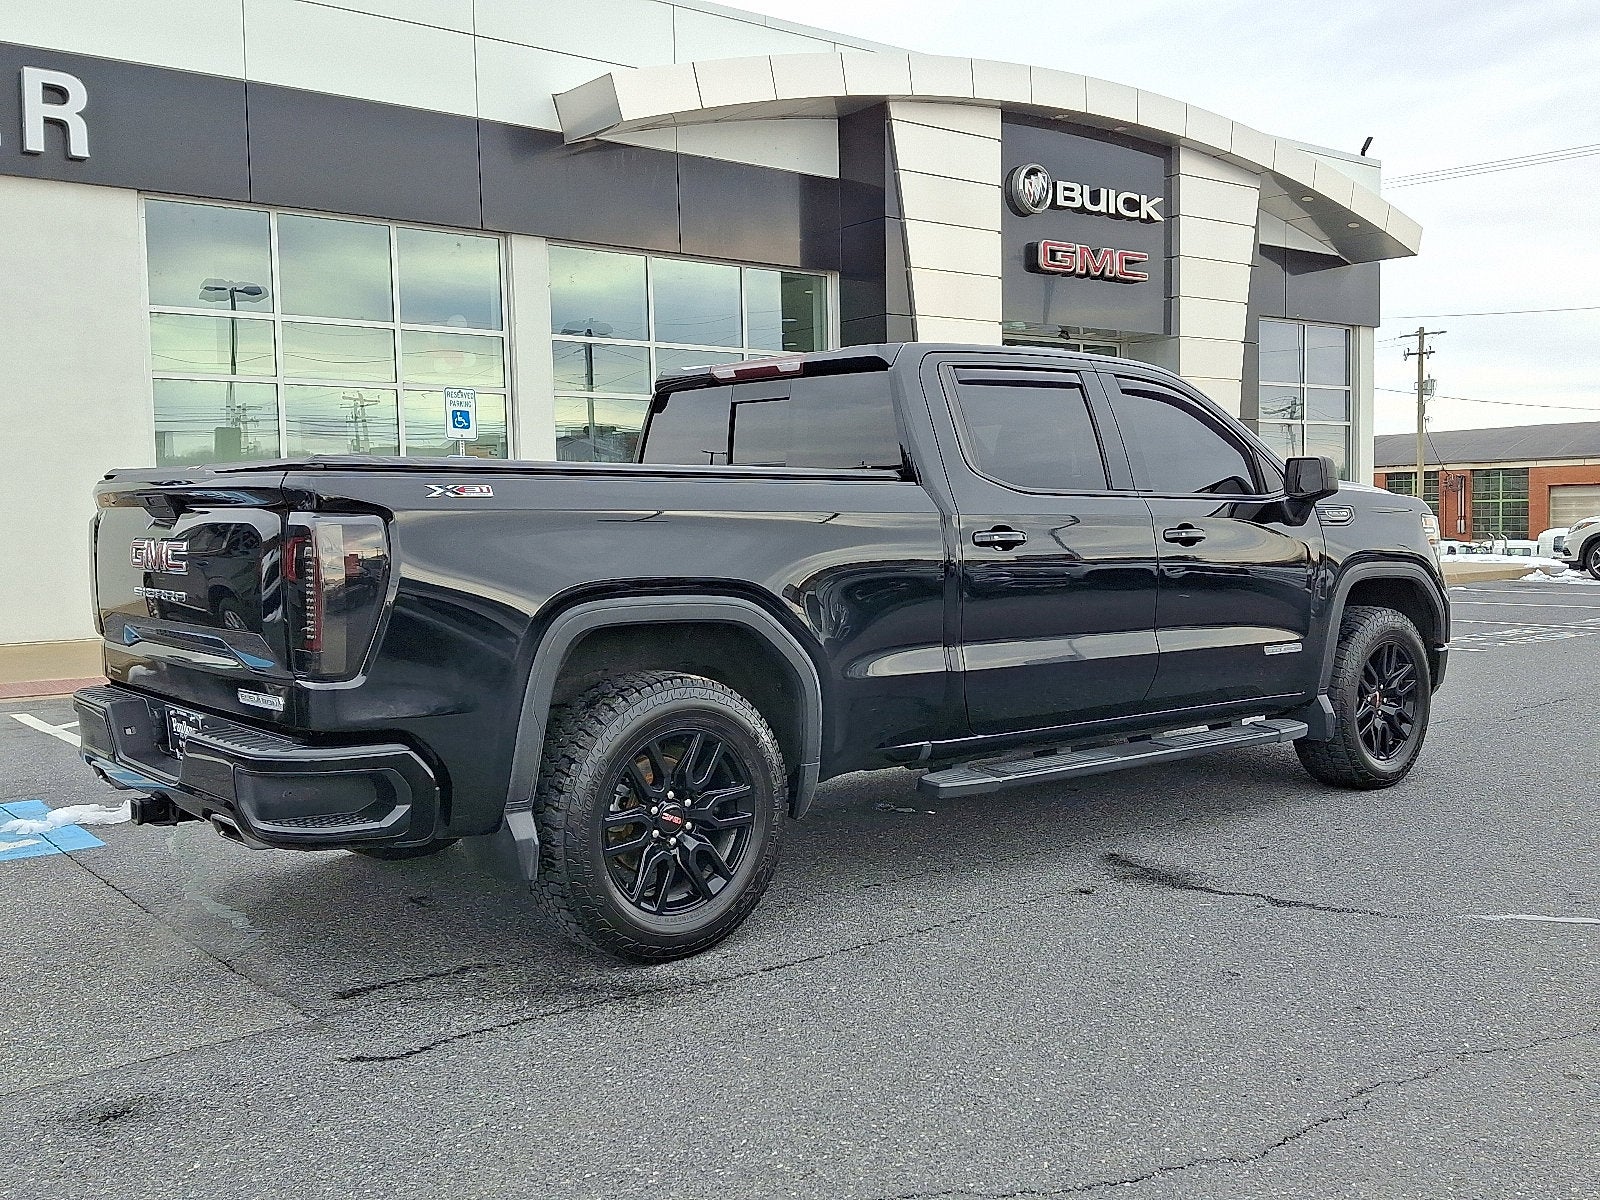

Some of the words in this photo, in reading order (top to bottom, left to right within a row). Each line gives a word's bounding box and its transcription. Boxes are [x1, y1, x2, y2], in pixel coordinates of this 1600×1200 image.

[0, 66, 90, 159] R
[1056, 180, 1164, 222] BUICK
[1038, 239, 1149, 282] GMC
[446, 390, 473, 400] RESERVED
[449, 399, 472, 408] PARKING
[130, 538, 189, 574] GMC
[133, 586, 188, 602] SIERRA
